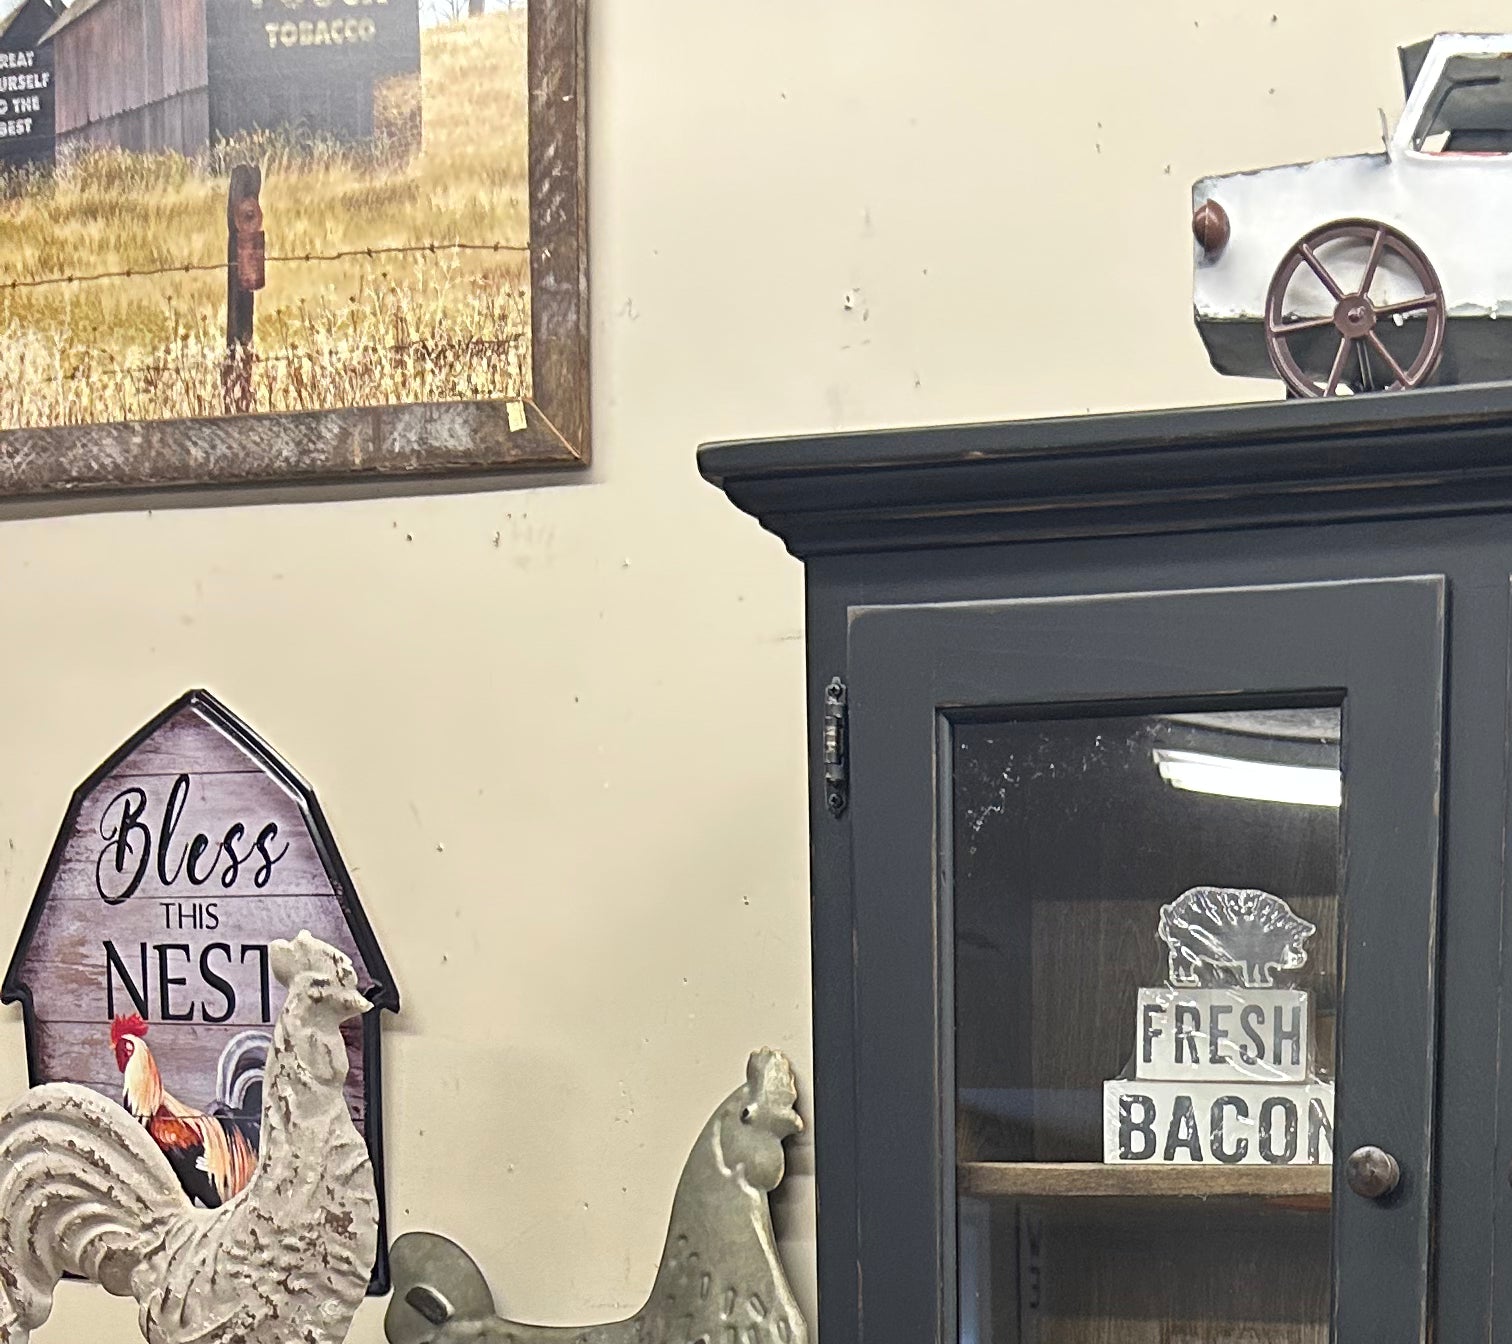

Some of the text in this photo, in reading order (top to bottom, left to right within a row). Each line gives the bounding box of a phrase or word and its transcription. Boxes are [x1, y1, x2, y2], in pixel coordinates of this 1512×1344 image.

[265, 18, 376, 48] TOBACCO
[12, 95, 40, 113] THE
[96, 774, 290, 905] Bless
[160, 902, 220, 930] THIS
[102, 939, 272, 1023] NEST
[1143, 1003, 1300, 1065] FRESH
